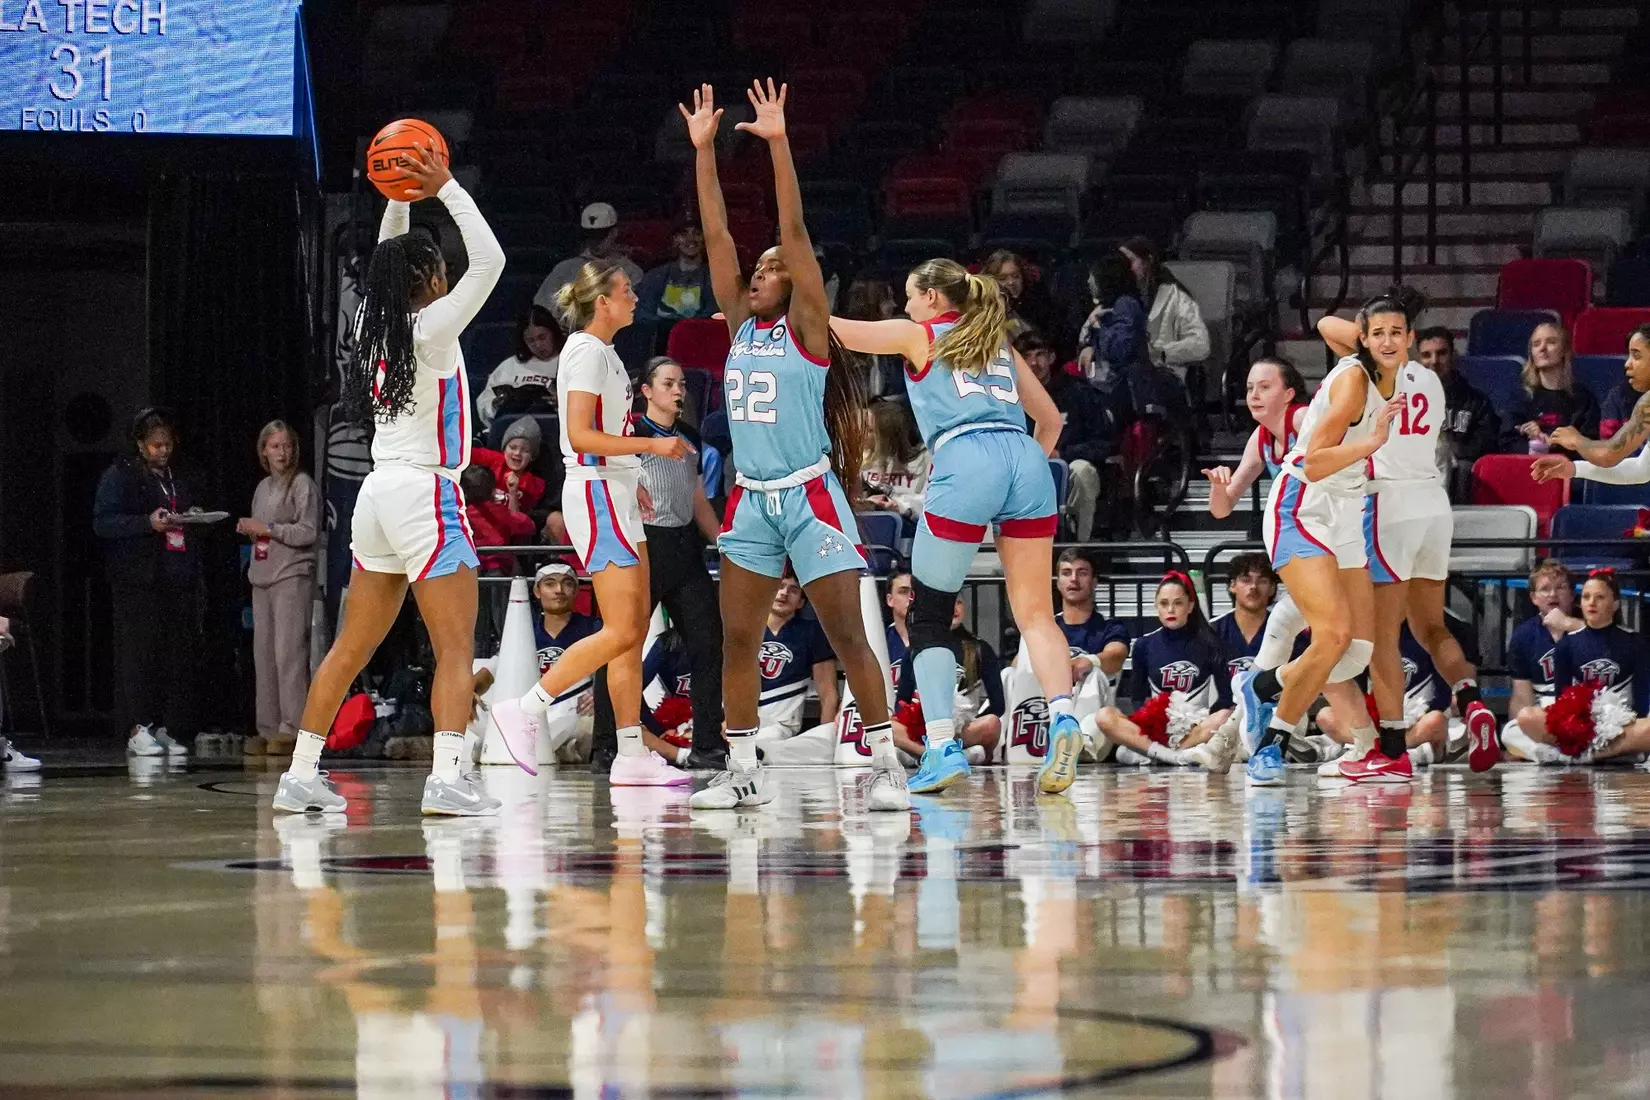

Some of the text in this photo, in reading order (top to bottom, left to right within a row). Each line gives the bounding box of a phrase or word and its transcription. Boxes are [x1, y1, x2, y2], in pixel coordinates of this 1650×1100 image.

[57, 0, 167, 34] TECH
[50, 44, 112, 100] 31
[21, 108, 109, 131] FOULS
[725, 369, 777, 424] 22
[952, 347, 1020, 405] 25
[1399, 392, 1430, 435] 12
[1161, 667, 1195, 692] LU
